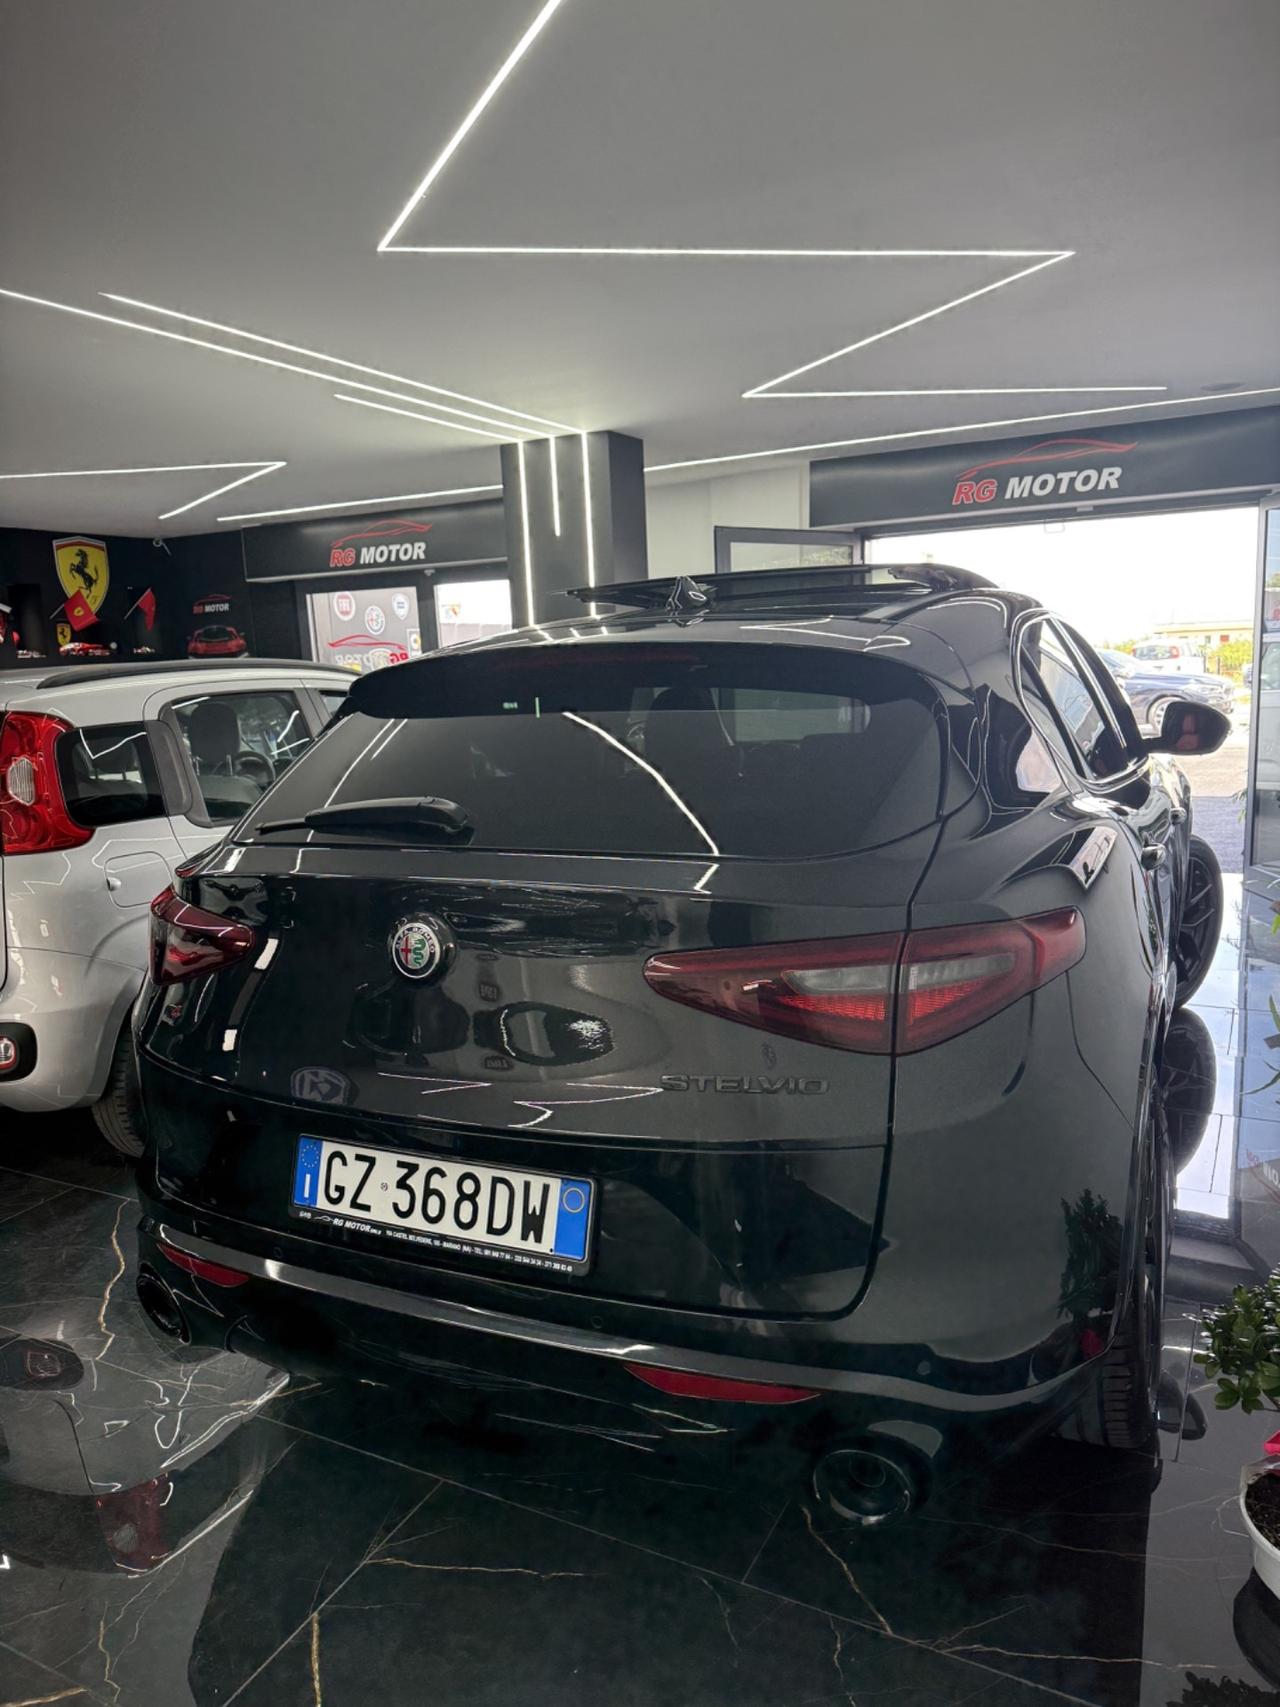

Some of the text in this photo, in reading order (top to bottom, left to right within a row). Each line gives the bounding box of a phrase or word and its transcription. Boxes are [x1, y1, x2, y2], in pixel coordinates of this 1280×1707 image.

[952, 467, 1122, 505] RG MOTOR
[329, 542, 426, 567] RG MOTOR
[204, 602, 230, 613] MOTOR
[660, 1075, 829, 1095] STELVIO
[324, 1151, 376, 1212] GZ
[392, 1160, 550, 1244] 368DW
[333, 1217, 344, 1227] RG
[344, 1220, 371, 1232] MOTOR
